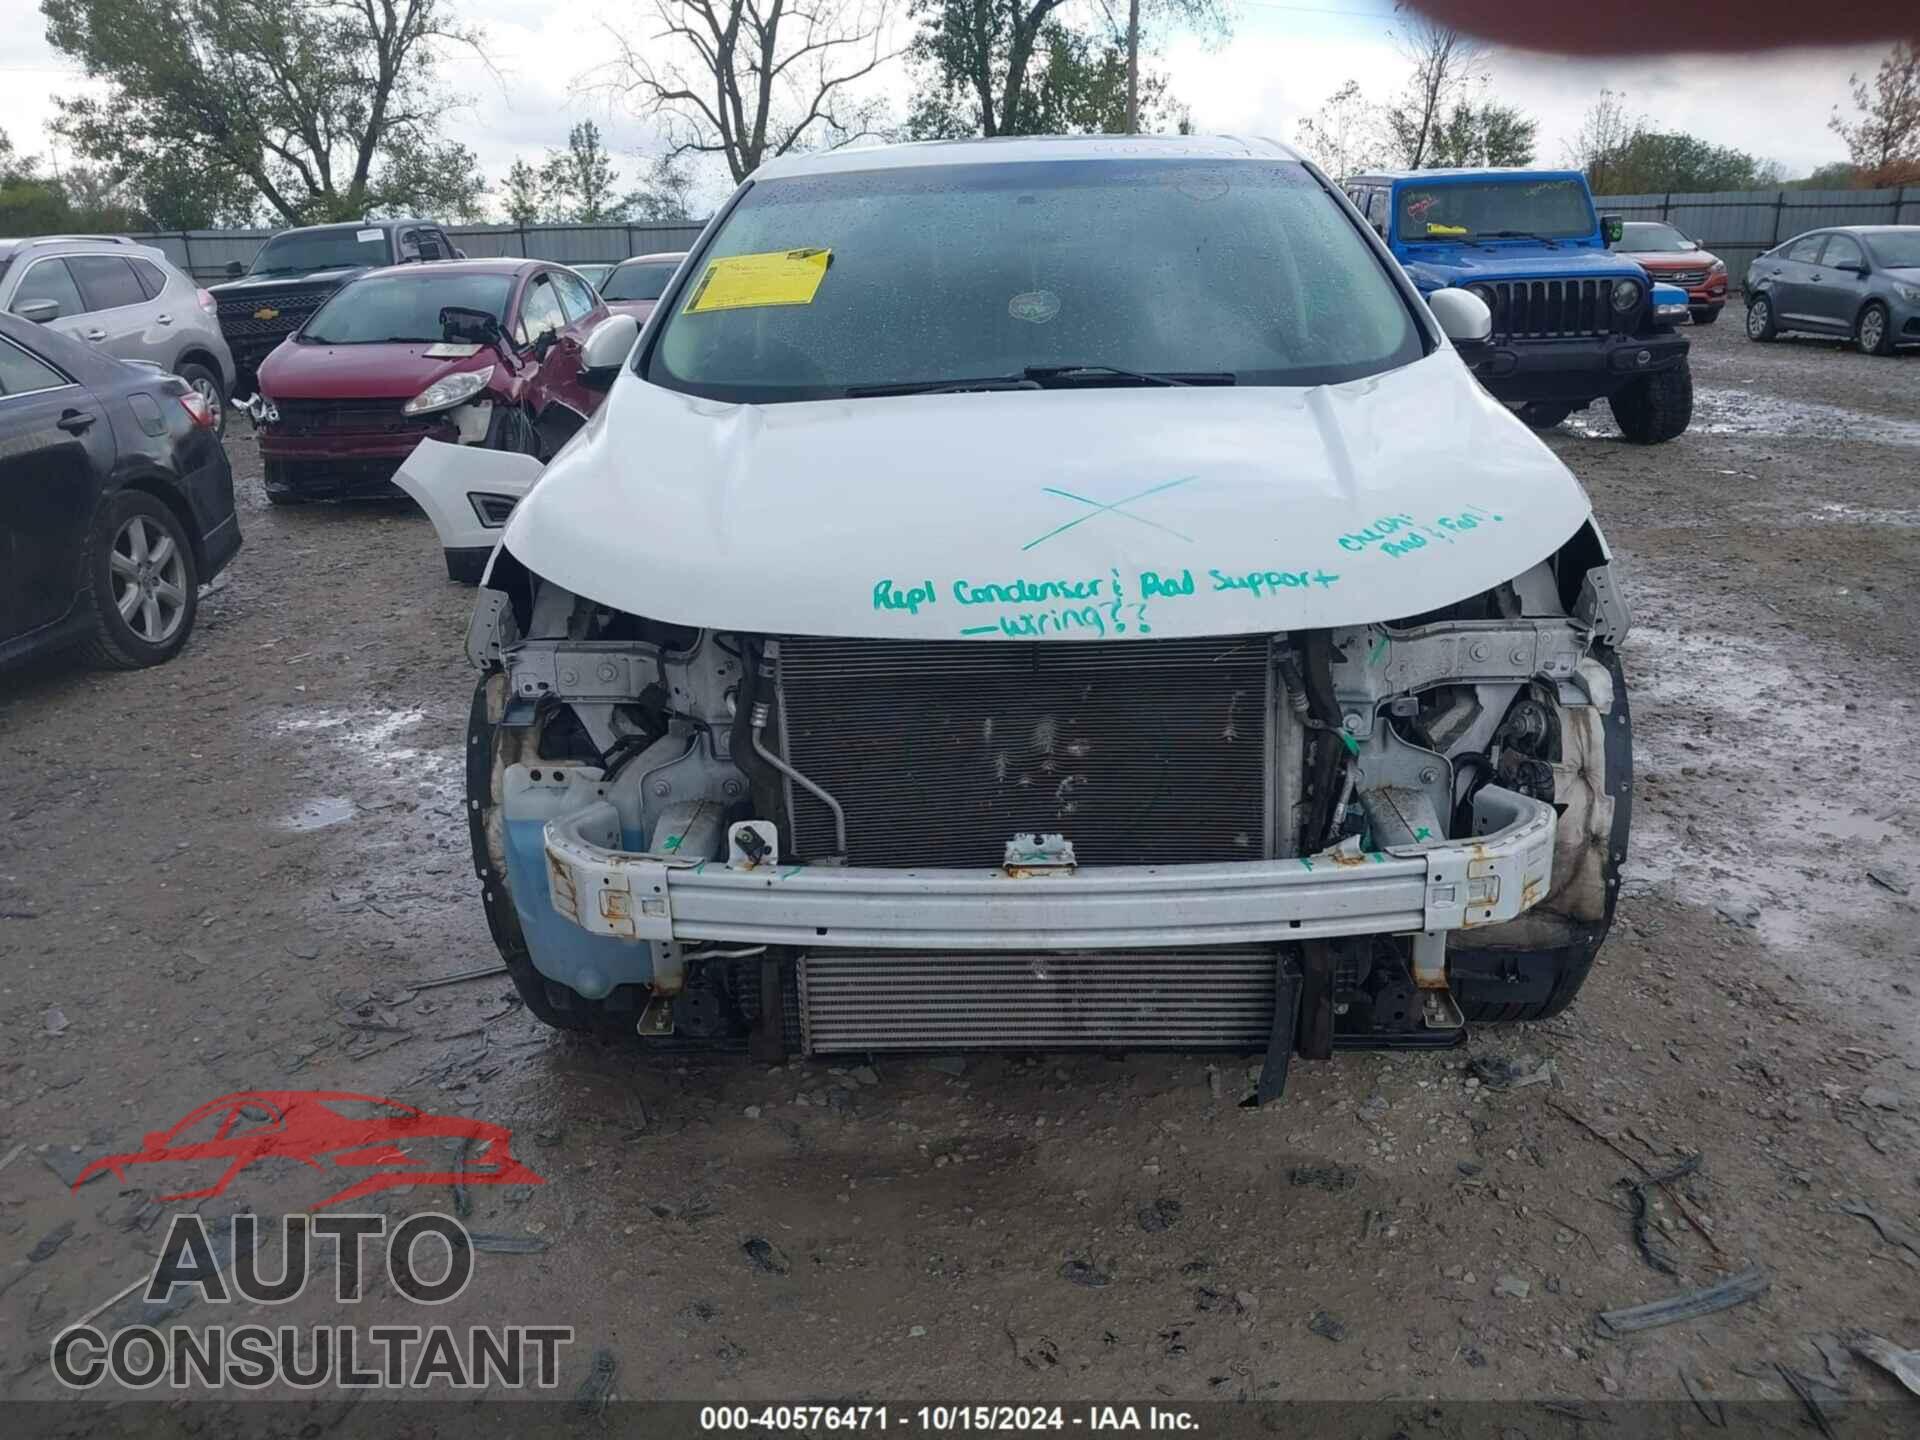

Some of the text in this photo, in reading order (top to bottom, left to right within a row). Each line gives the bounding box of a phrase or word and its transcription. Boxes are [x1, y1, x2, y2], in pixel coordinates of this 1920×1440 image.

[873, 579, 936, 614] Repl
[953, 579, 1103, 605] Condenser
[1139, 570, 1195, 599] Rad
[1208, 567, 1341, 594] Support
